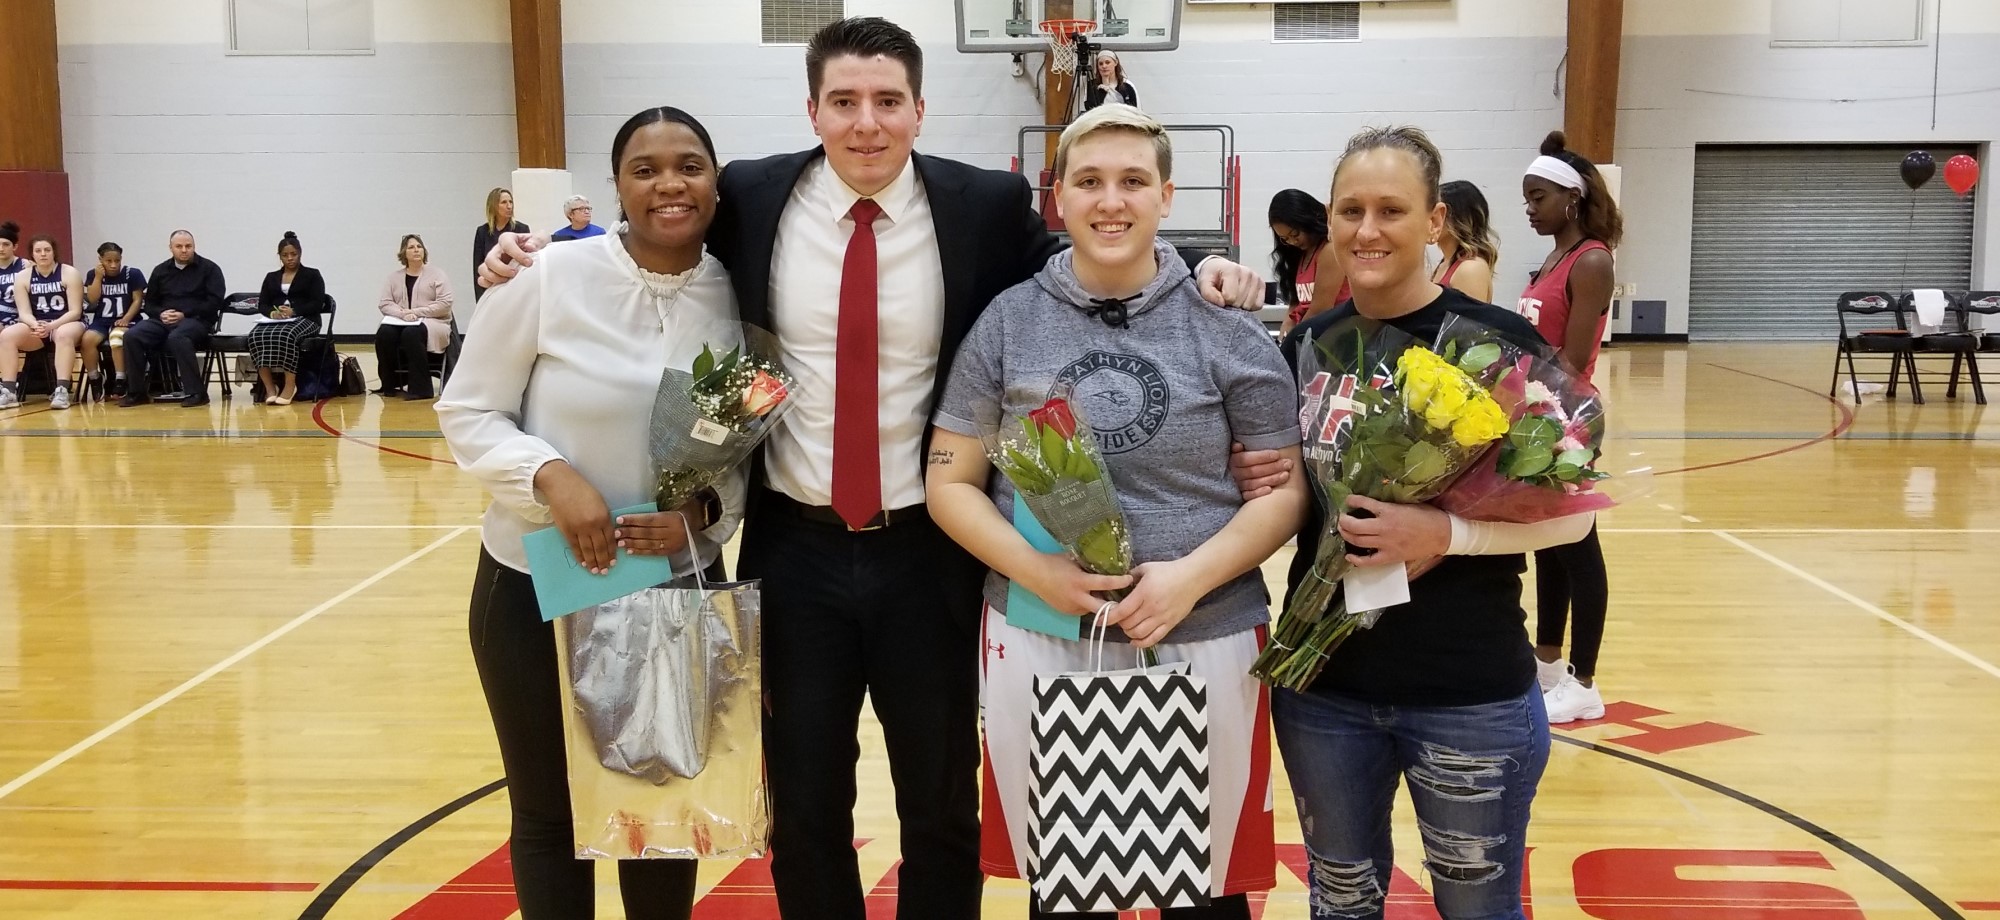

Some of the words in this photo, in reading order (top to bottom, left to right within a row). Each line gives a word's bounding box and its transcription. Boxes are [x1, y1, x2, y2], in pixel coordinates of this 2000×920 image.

[36, 295, 65, 313] 40
[102, 297, 124, 318] 21
[1075, 353, 1142, 376] ATHYN
[1142, 372, 1165, 430] LIONS
[1059, 490, 1087, 506] BOUQUET
